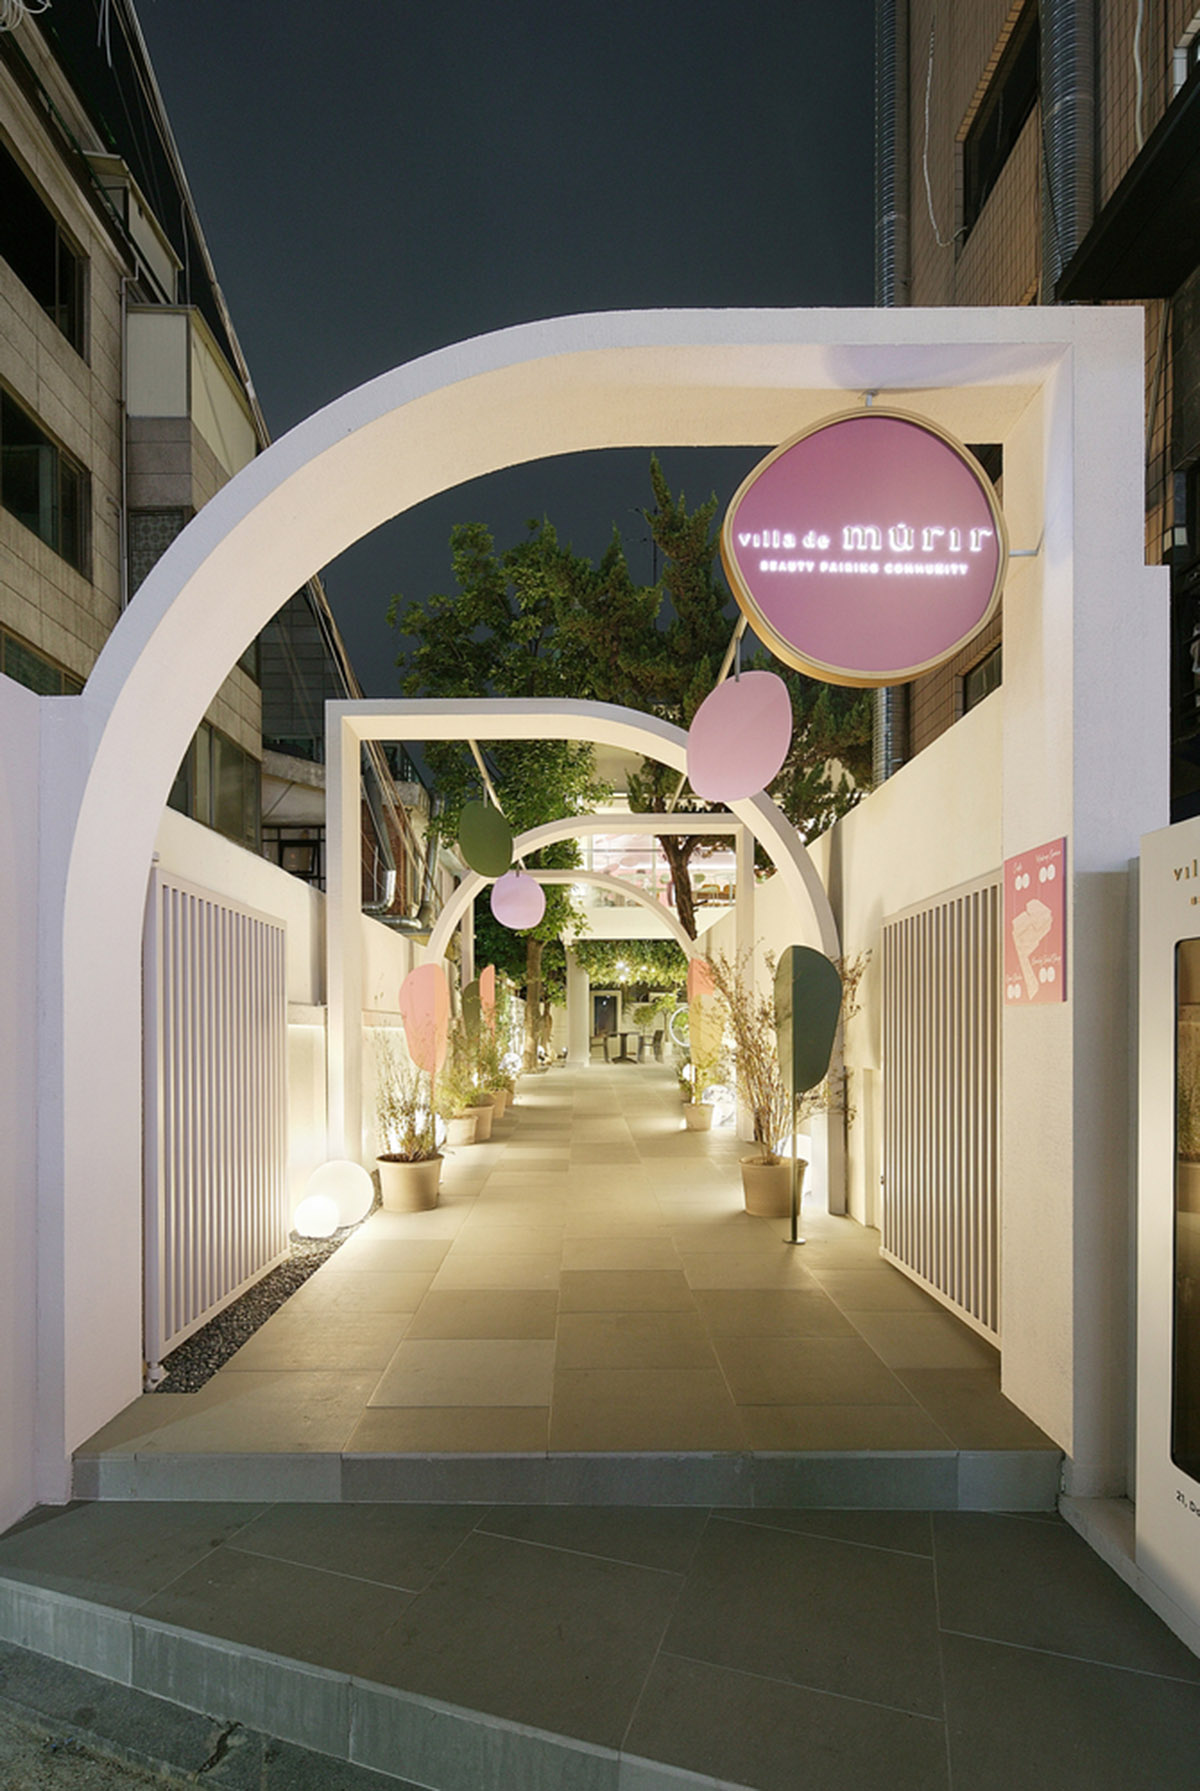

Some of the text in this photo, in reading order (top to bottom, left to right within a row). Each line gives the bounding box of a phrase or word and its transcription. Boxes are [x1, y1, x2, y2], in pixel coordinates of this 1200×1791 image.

[738, 529, 796, 548] villa
[802, 530, 830, 549] de
[759, 560, 815, 572] BEAUTY
[884, 563, 968, 575] COMMUNITY
